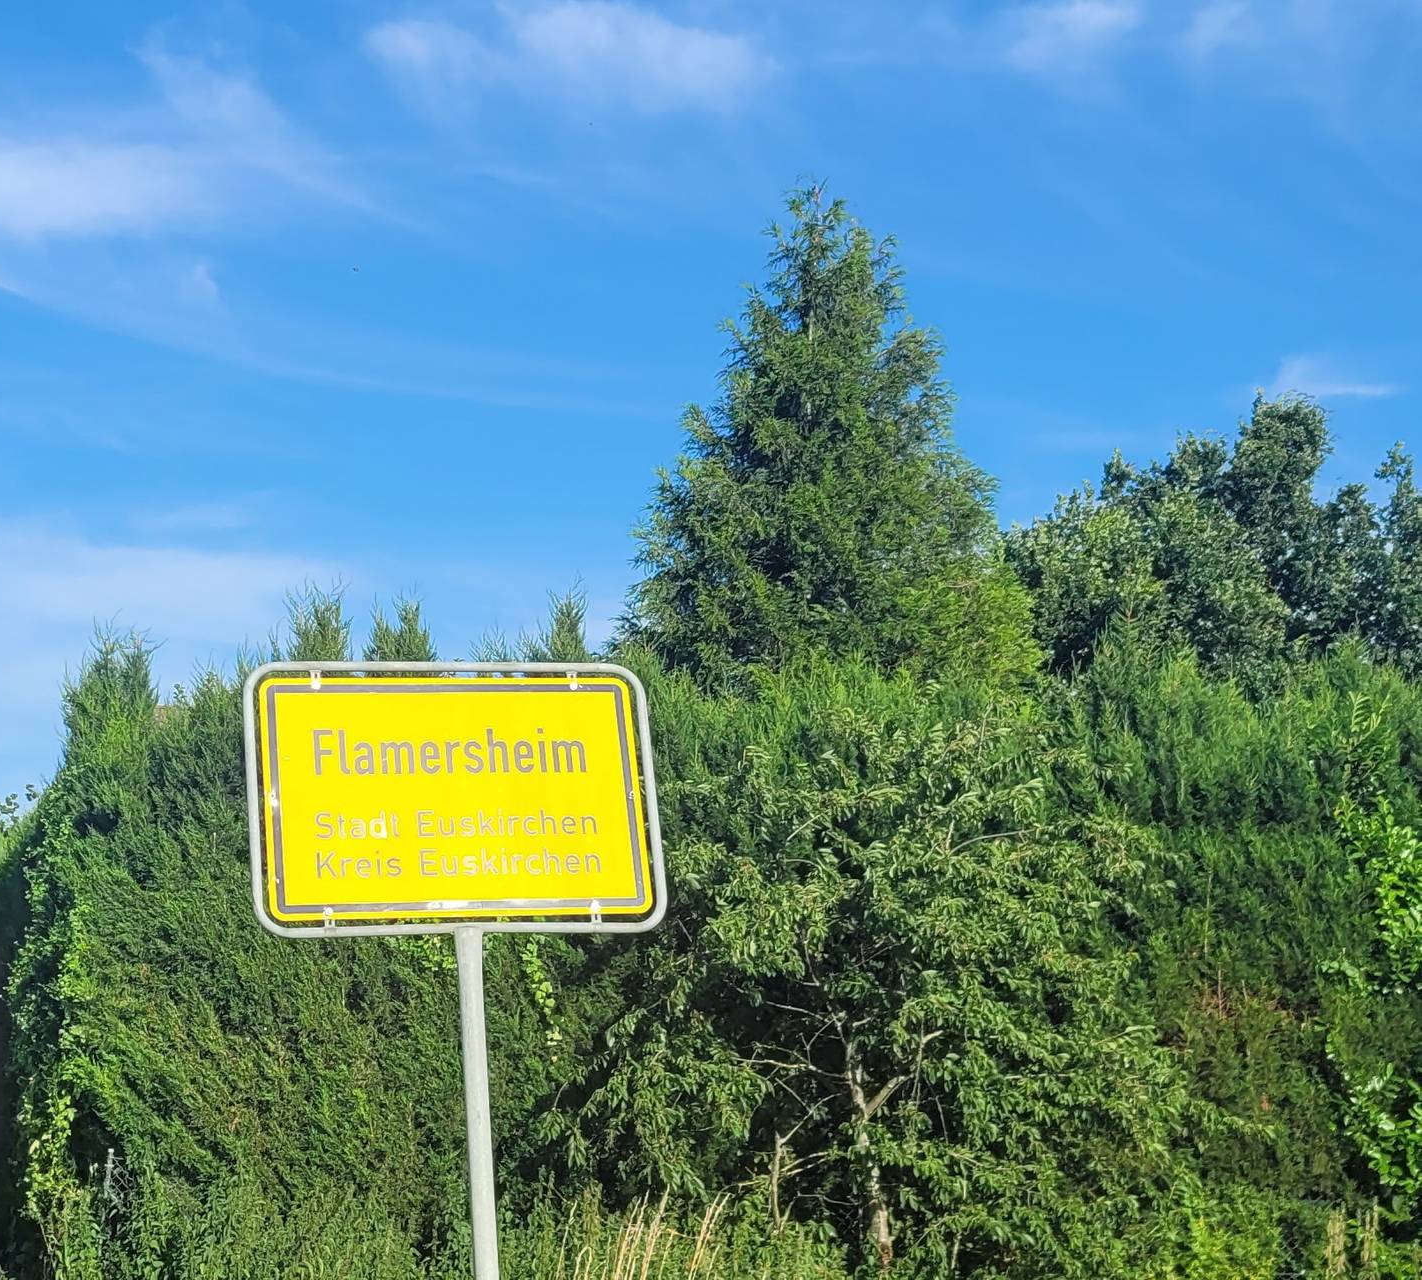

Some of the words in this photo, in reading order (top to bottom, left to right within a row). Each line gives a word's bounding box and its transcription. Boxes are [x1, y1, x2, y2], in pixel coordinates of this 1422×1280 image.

[312, 727, 588, 775] Flamersheim
[315, 810, 400, 840] Stadt
[417, 809, 598, 838] Euskirchen
[315, 849, 402, 878] Kreis
[420, 848, 602, 876] Euskirchen
